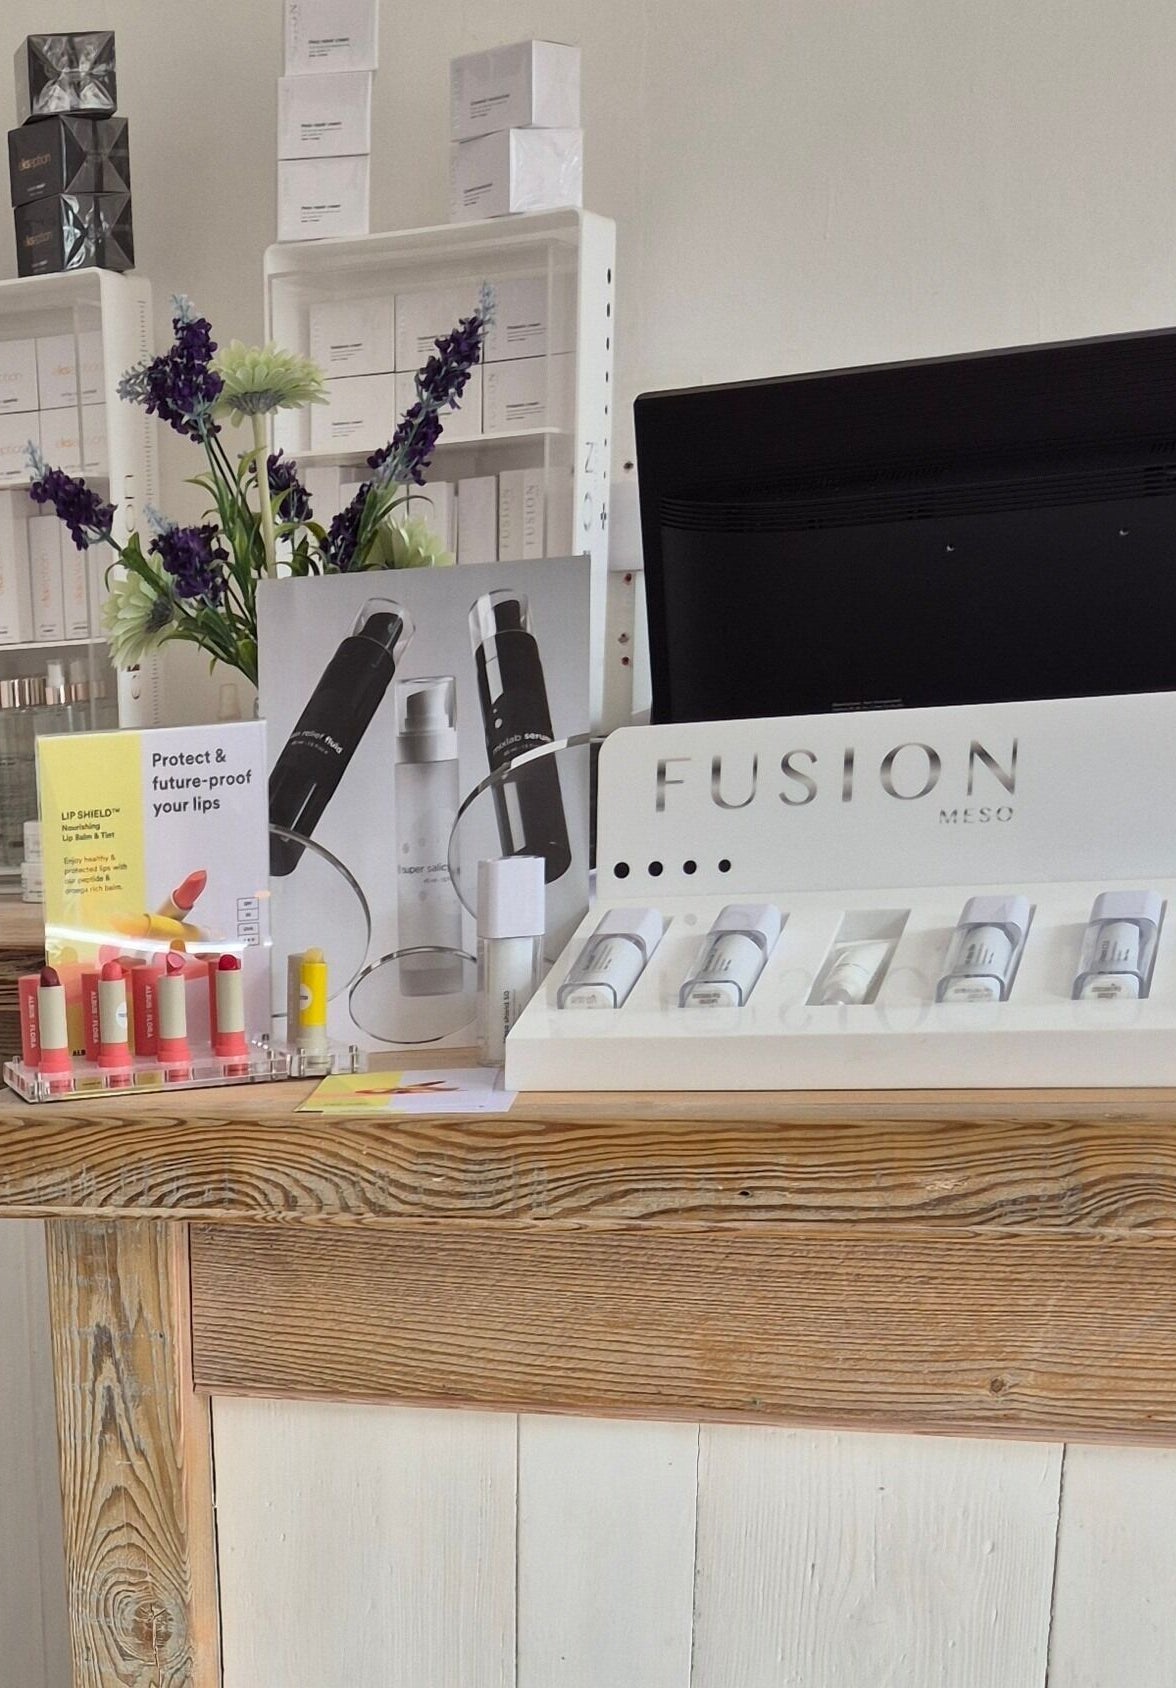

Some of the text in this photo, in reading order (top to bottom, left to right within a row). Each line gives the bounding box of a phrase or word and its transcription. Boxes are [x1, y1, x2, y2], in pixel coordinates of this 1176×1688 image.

[324, 736, 343, 754] fluid
[152, 748, 227, 768] Protect &
[152, 769, 253, 791] future-proof
[655, 737, 1019, 813] FUSION
[153, 796, 221, 818] your lips
[939, 806, 1015, 824] MESO
[61, 811, 76, 821] LIP
[61, 822, 101, 832] Nourishing
[62, 831, 116, 843] Lip Balm & Tint
[64, 853, 116, 867] Enjoy healthy &
[64, 863, 128, 876] protected lips with
[90, 884, 103, 893] rich
